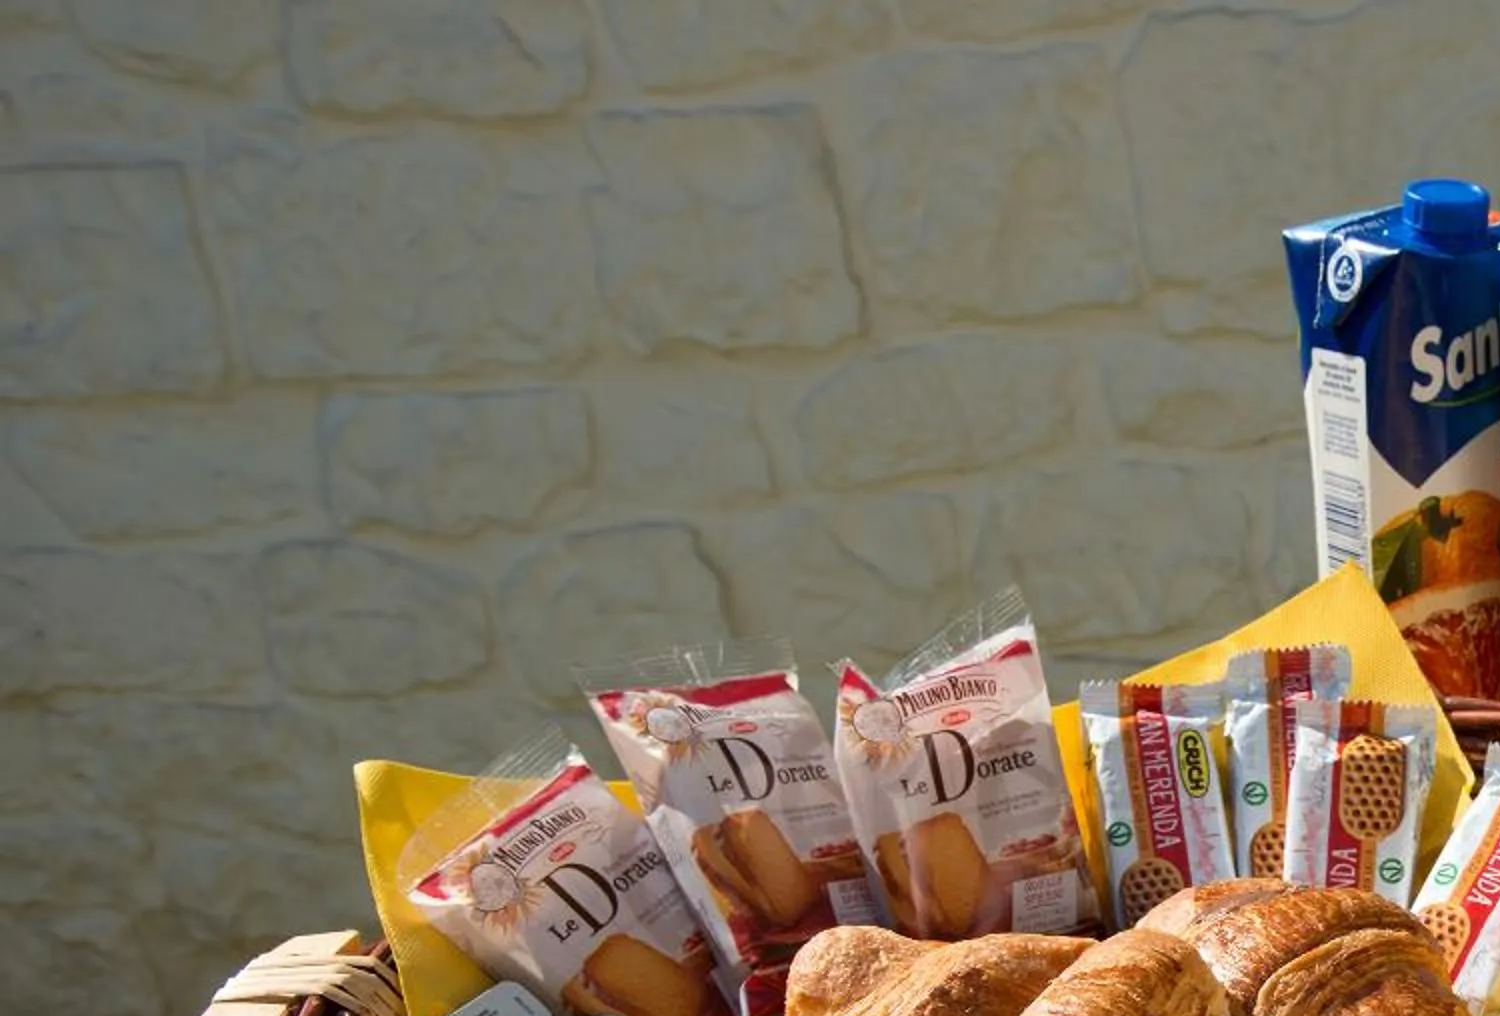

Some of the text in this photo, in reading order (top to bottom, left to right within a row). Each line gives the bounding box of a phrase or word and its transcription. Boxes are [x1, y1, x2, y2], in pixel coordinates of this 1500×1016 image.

[706, 737, 830, 802] Le Dorate
[900, 778, 929, 799] Le
[922, 729, 1037, 807] Dorate
[1141, 748, 1182, 850] MERENDA
[541, 851, 664, 938] Dorate
[548, 916, 581, 943] Le
